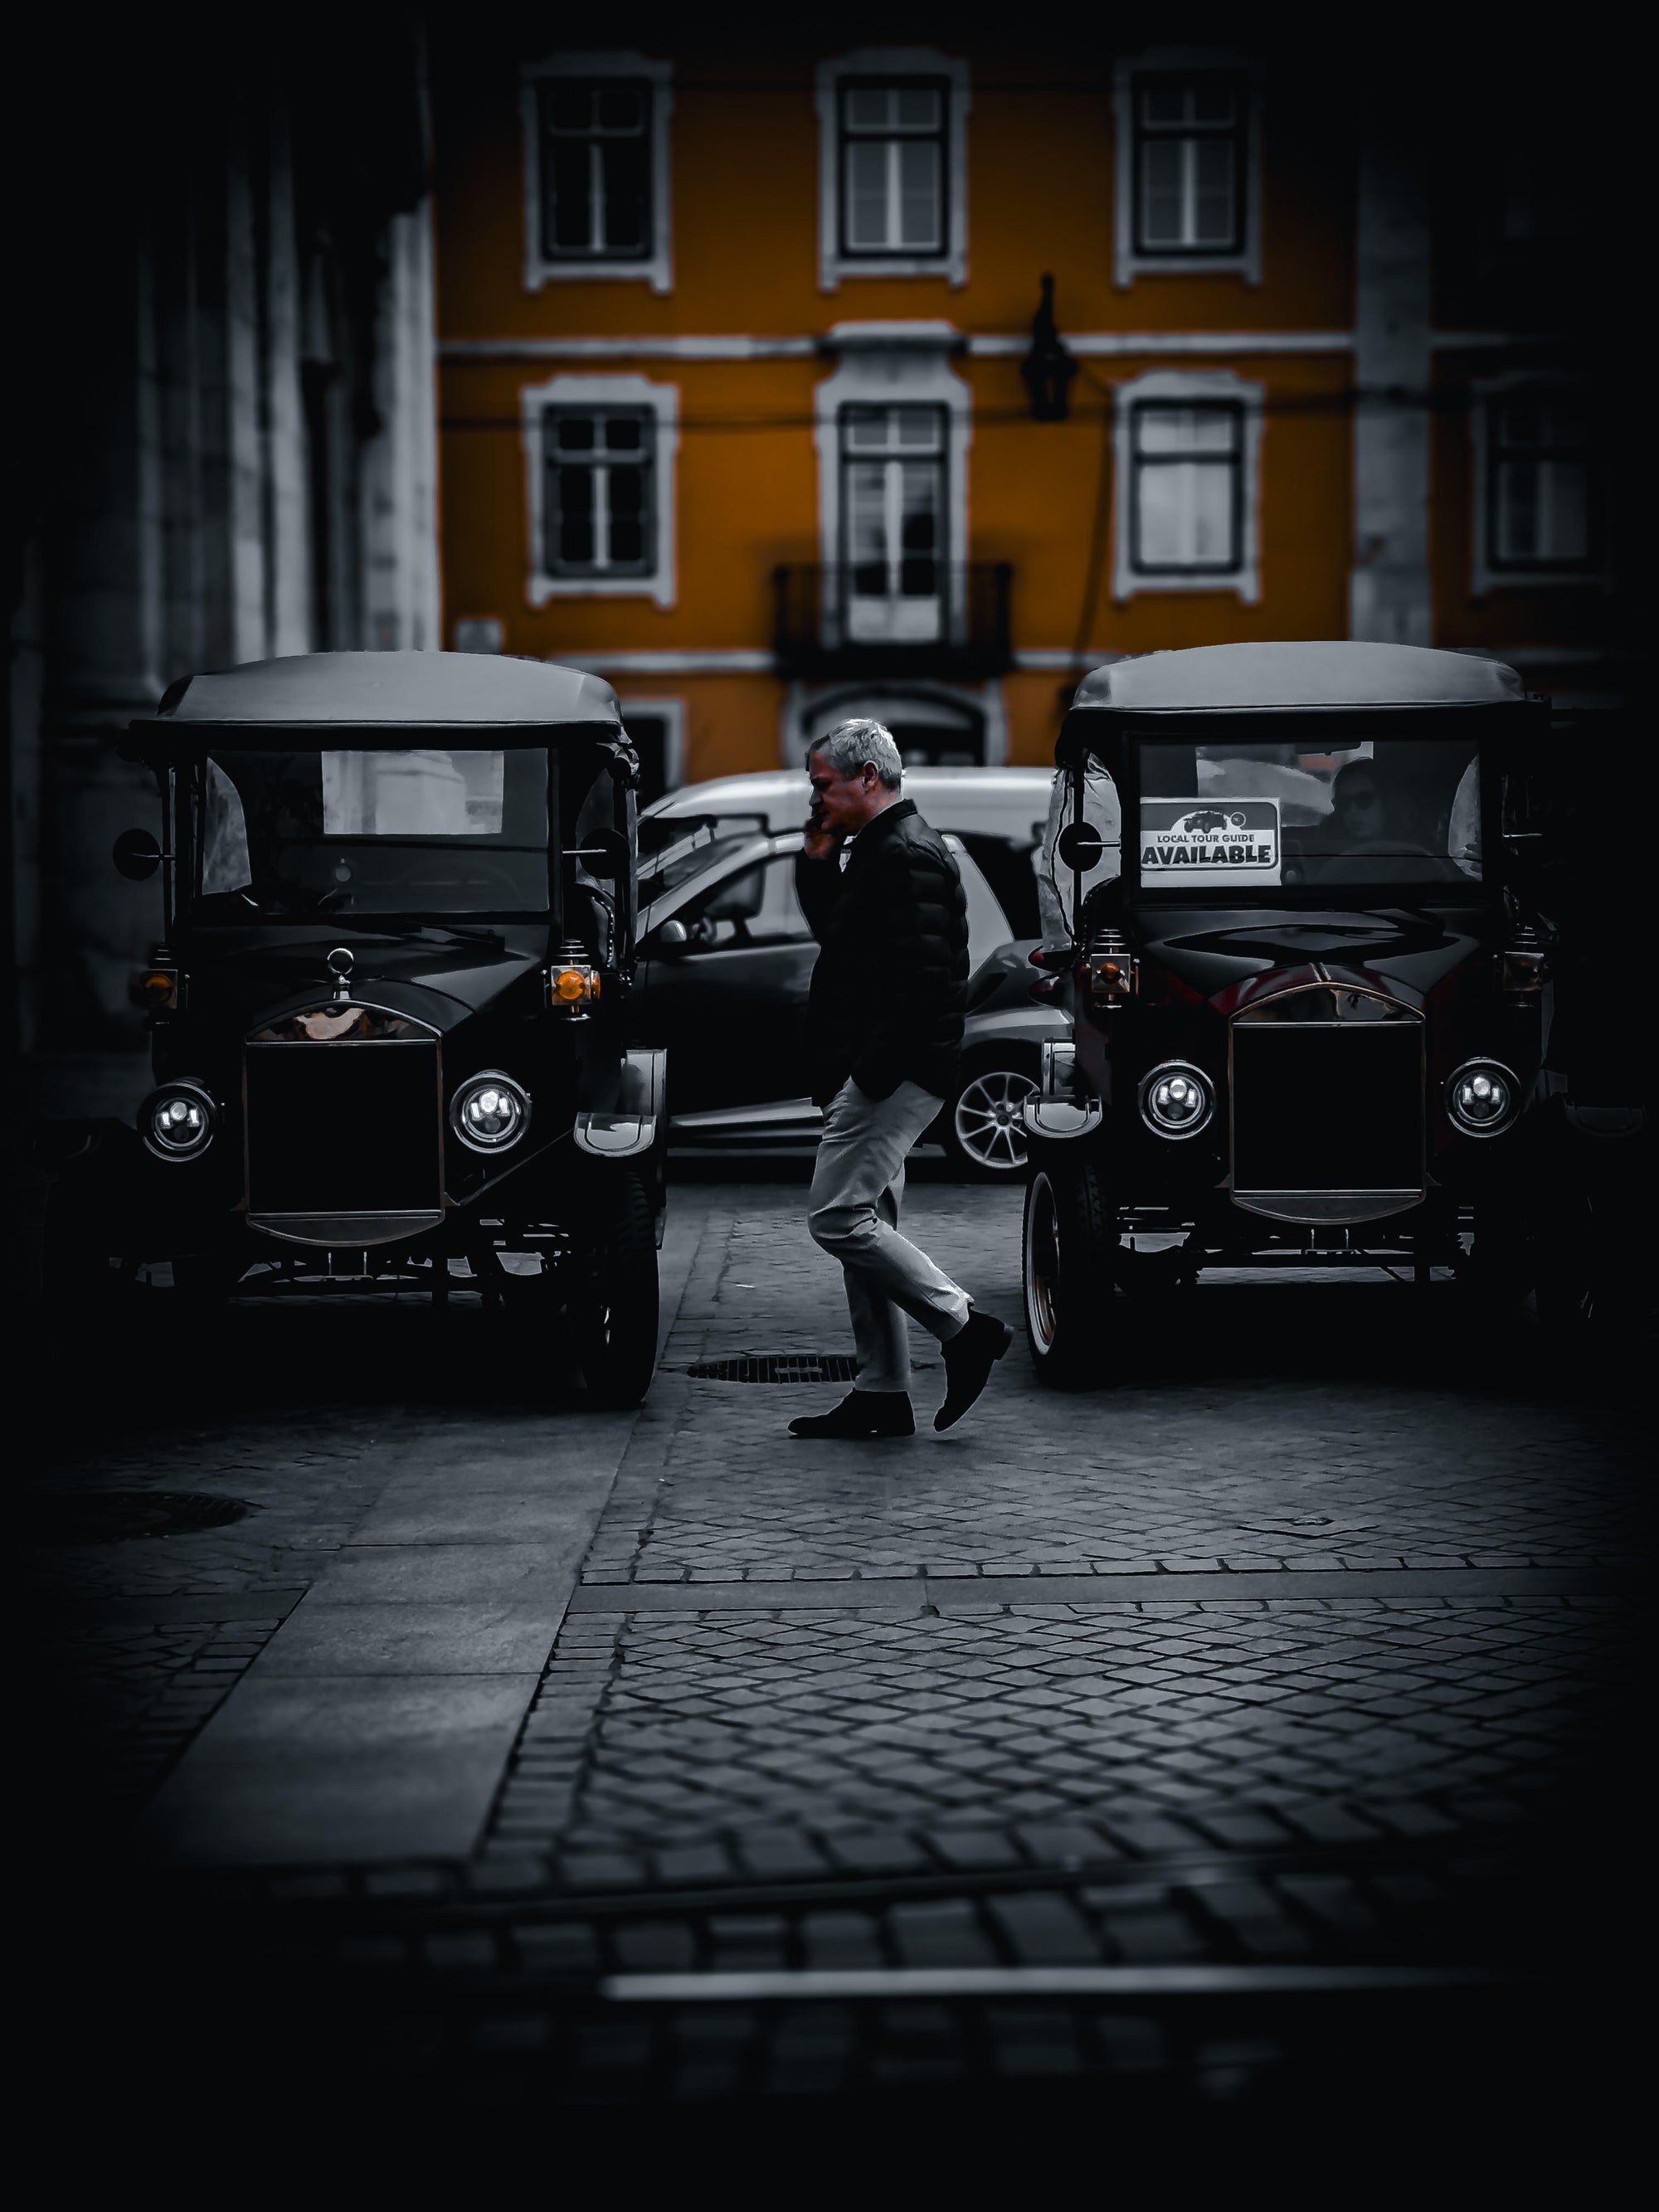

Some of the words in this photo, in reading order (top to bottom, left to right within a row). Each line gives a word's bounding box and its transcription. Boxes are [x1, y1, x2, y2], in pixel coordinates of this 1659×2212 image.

[1157, 834, 1190, 843] LOCAL
[1191, 834, 1219, 843] TOUR
[1222, 834, 1255, 843] GUIDE
[1141, 845, 1272, 864] AVAILABLE
